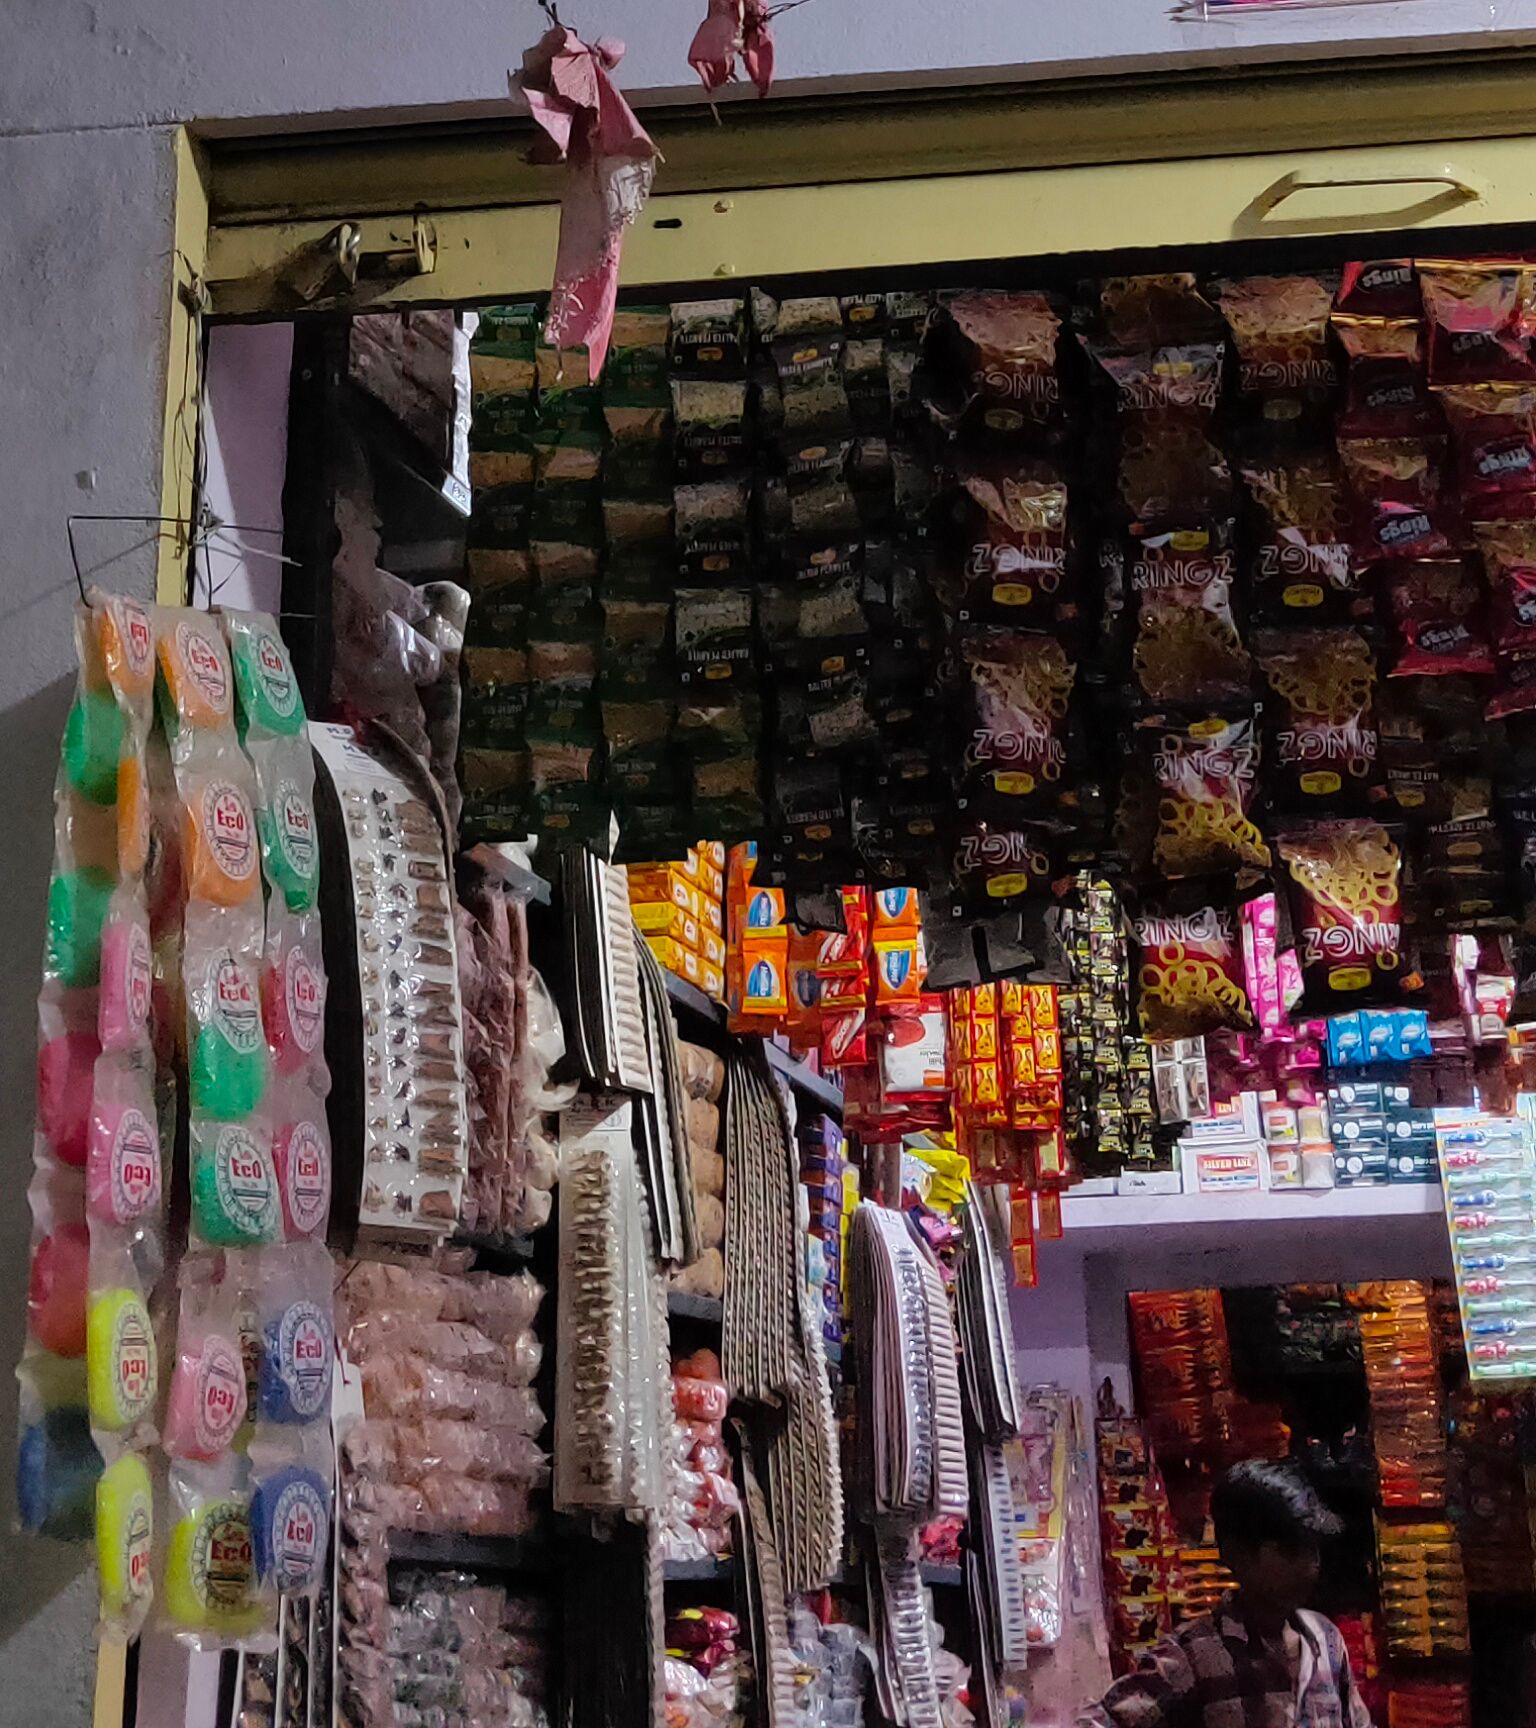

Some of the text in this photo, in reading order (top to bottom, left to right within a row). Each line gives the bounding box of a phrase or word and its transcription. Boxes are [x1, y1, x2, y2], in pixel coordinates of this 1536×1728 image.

[1131, 555, 1237, 592] RINGZ
[1276, 728, 1377, 764] RINGZ
[1302, 923, 1402, 961] RINGZ
